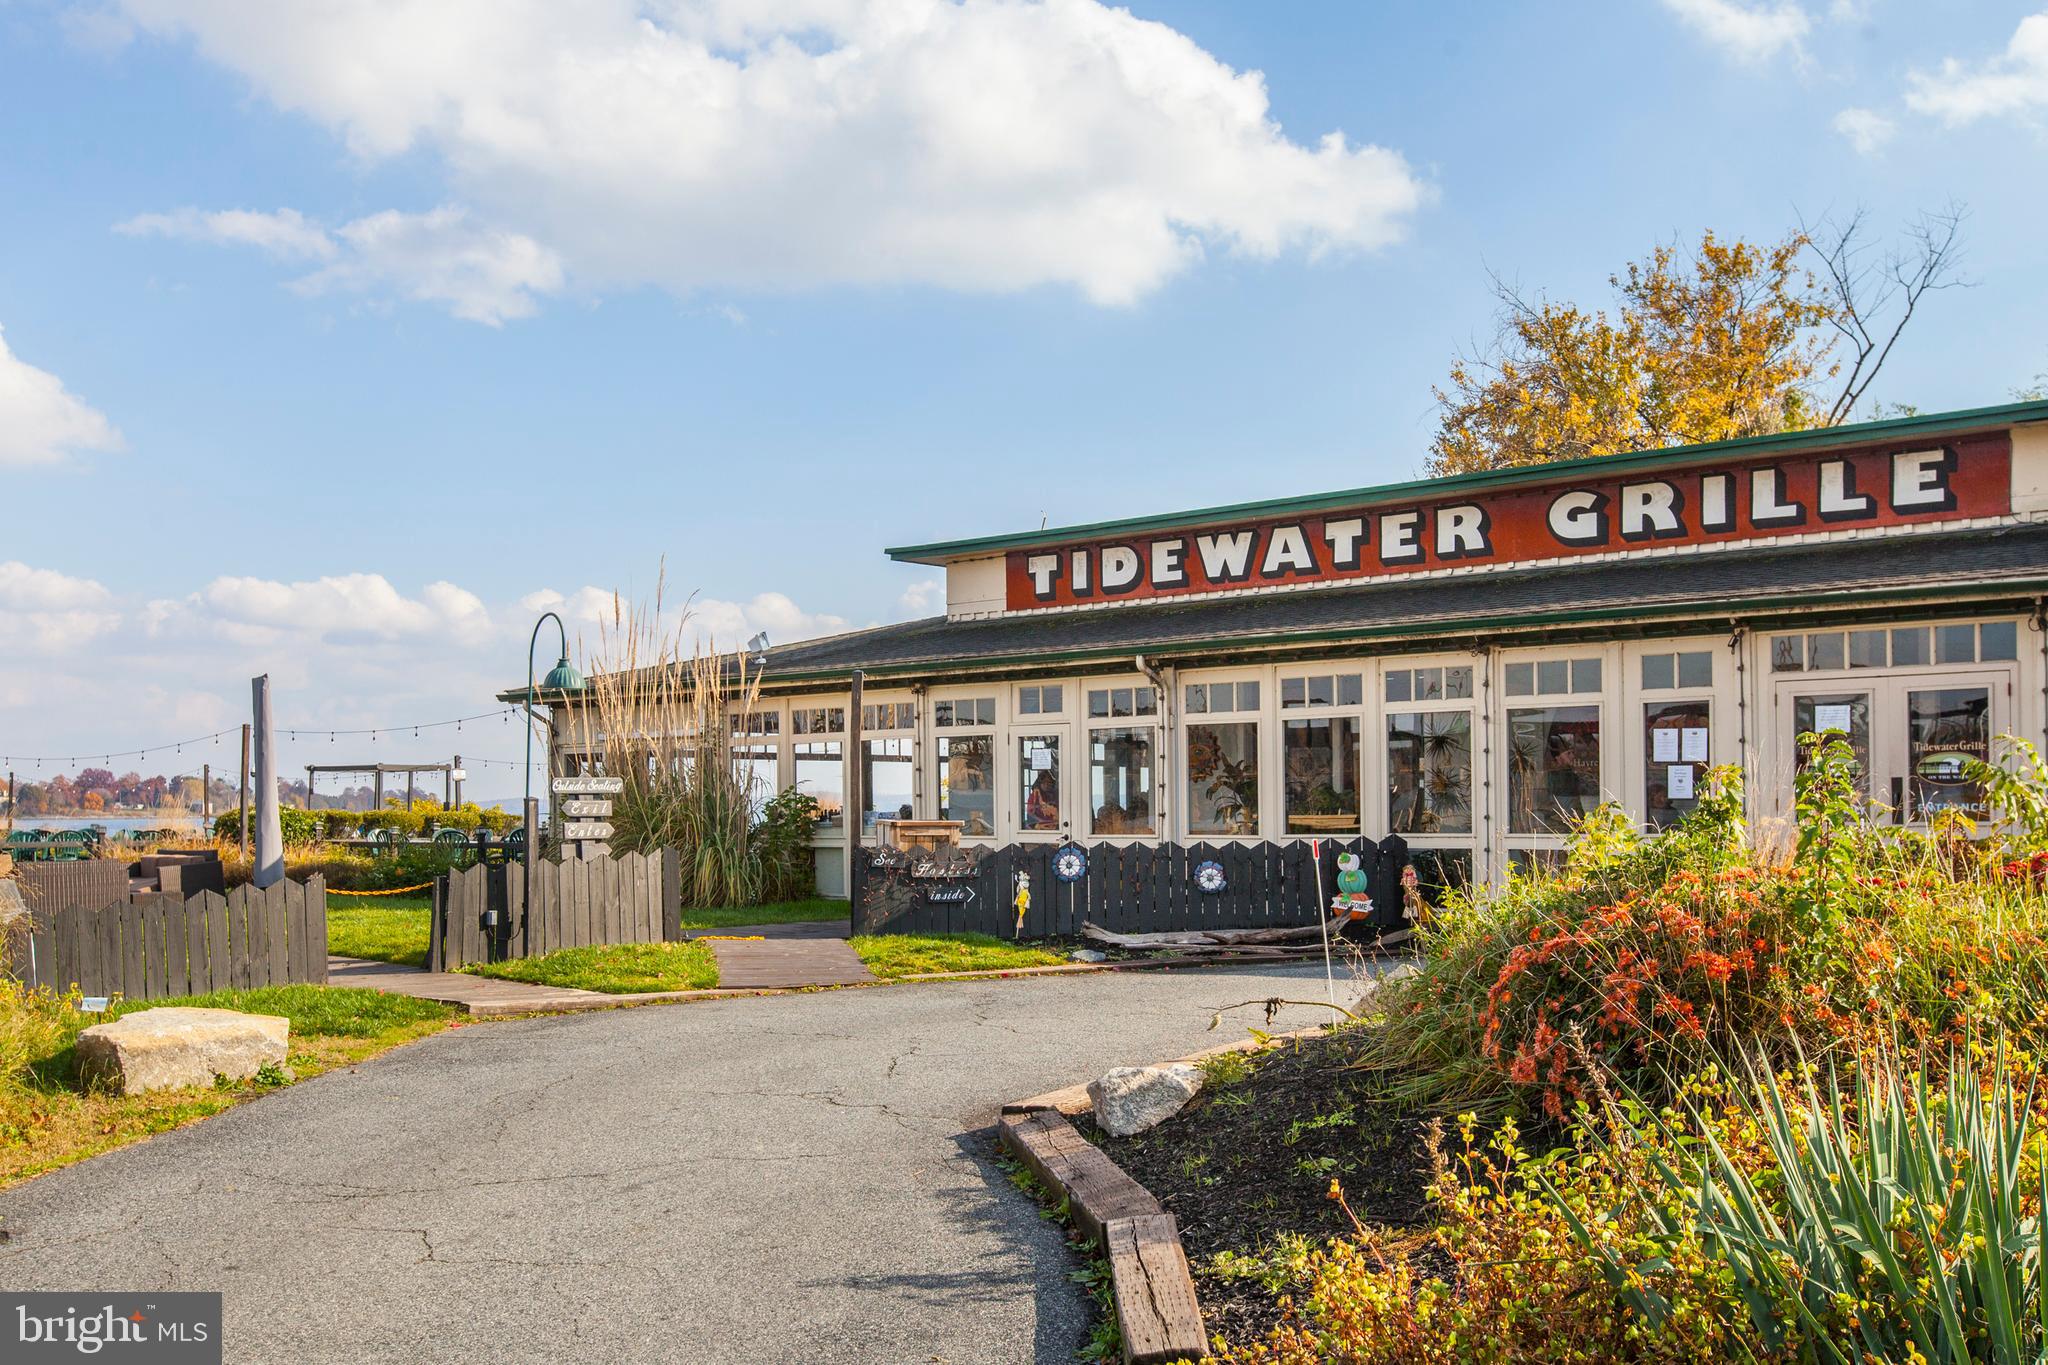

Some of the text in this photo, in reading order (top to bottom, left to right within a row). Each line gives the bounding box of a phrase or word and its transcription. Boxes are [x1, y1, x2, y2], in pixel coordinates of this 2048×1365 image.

[1027, 447, 1957, 600] TIDEWATER GRILLE
[1914, 740, 1987, 751] Tidewater Grille
[552, 779, 624, 793] Outside Seating
[571, 801, 608, 815] Exit
[567, 824, 607, 837] Enter
[874, 852, 897, 866] See
[915, 862, 978, 876] Hostess
[930, 889, 966, 901] inside
